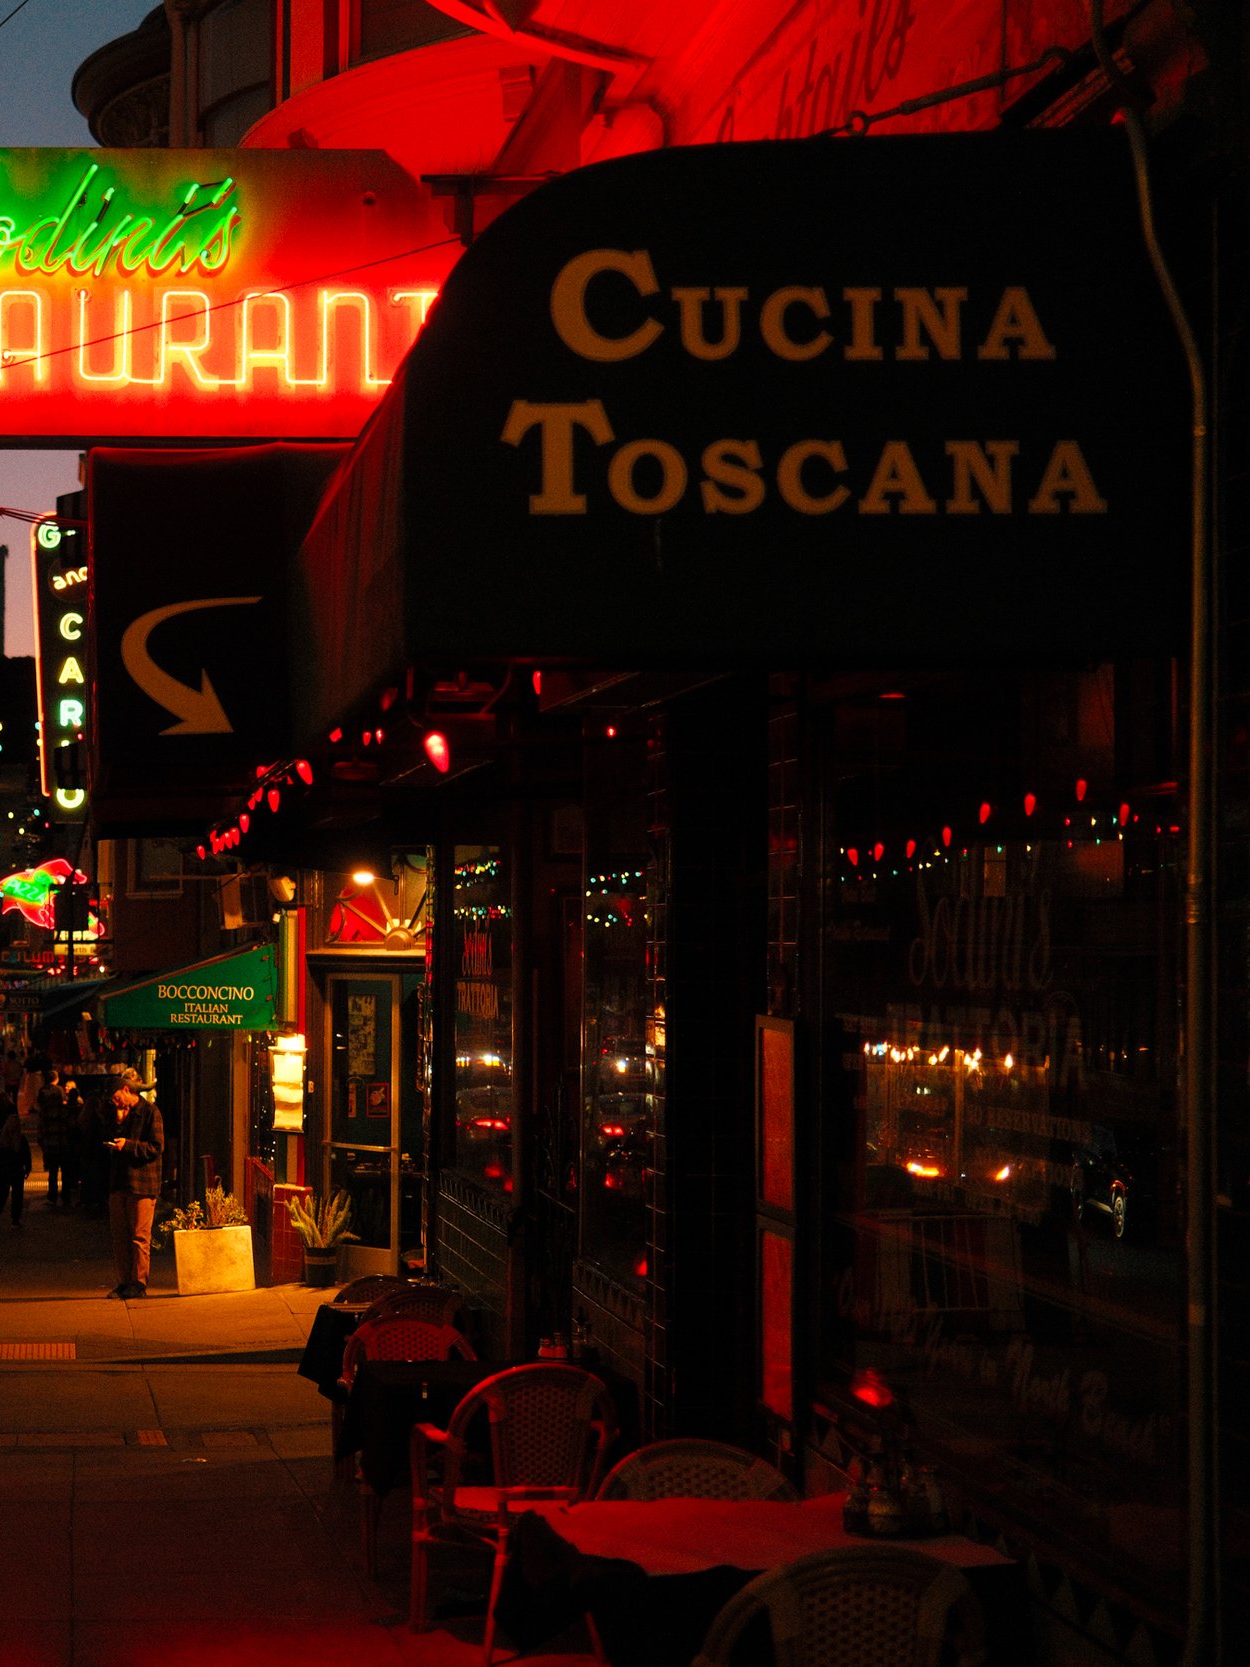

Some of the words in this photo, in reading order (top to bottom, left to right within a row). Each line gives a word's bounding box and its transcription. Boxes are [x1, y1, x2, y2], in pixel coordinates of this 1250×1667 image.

[549, 247, 1058, 364] CUCINA
[500, 398, 1109, 516] TOSCANA
[157, 984, 255, 1001] BOCCONCINO
[184, 1002, 229, 1014] ITALIAN
[170, 1013, 244, 1025] RESTAURANT
